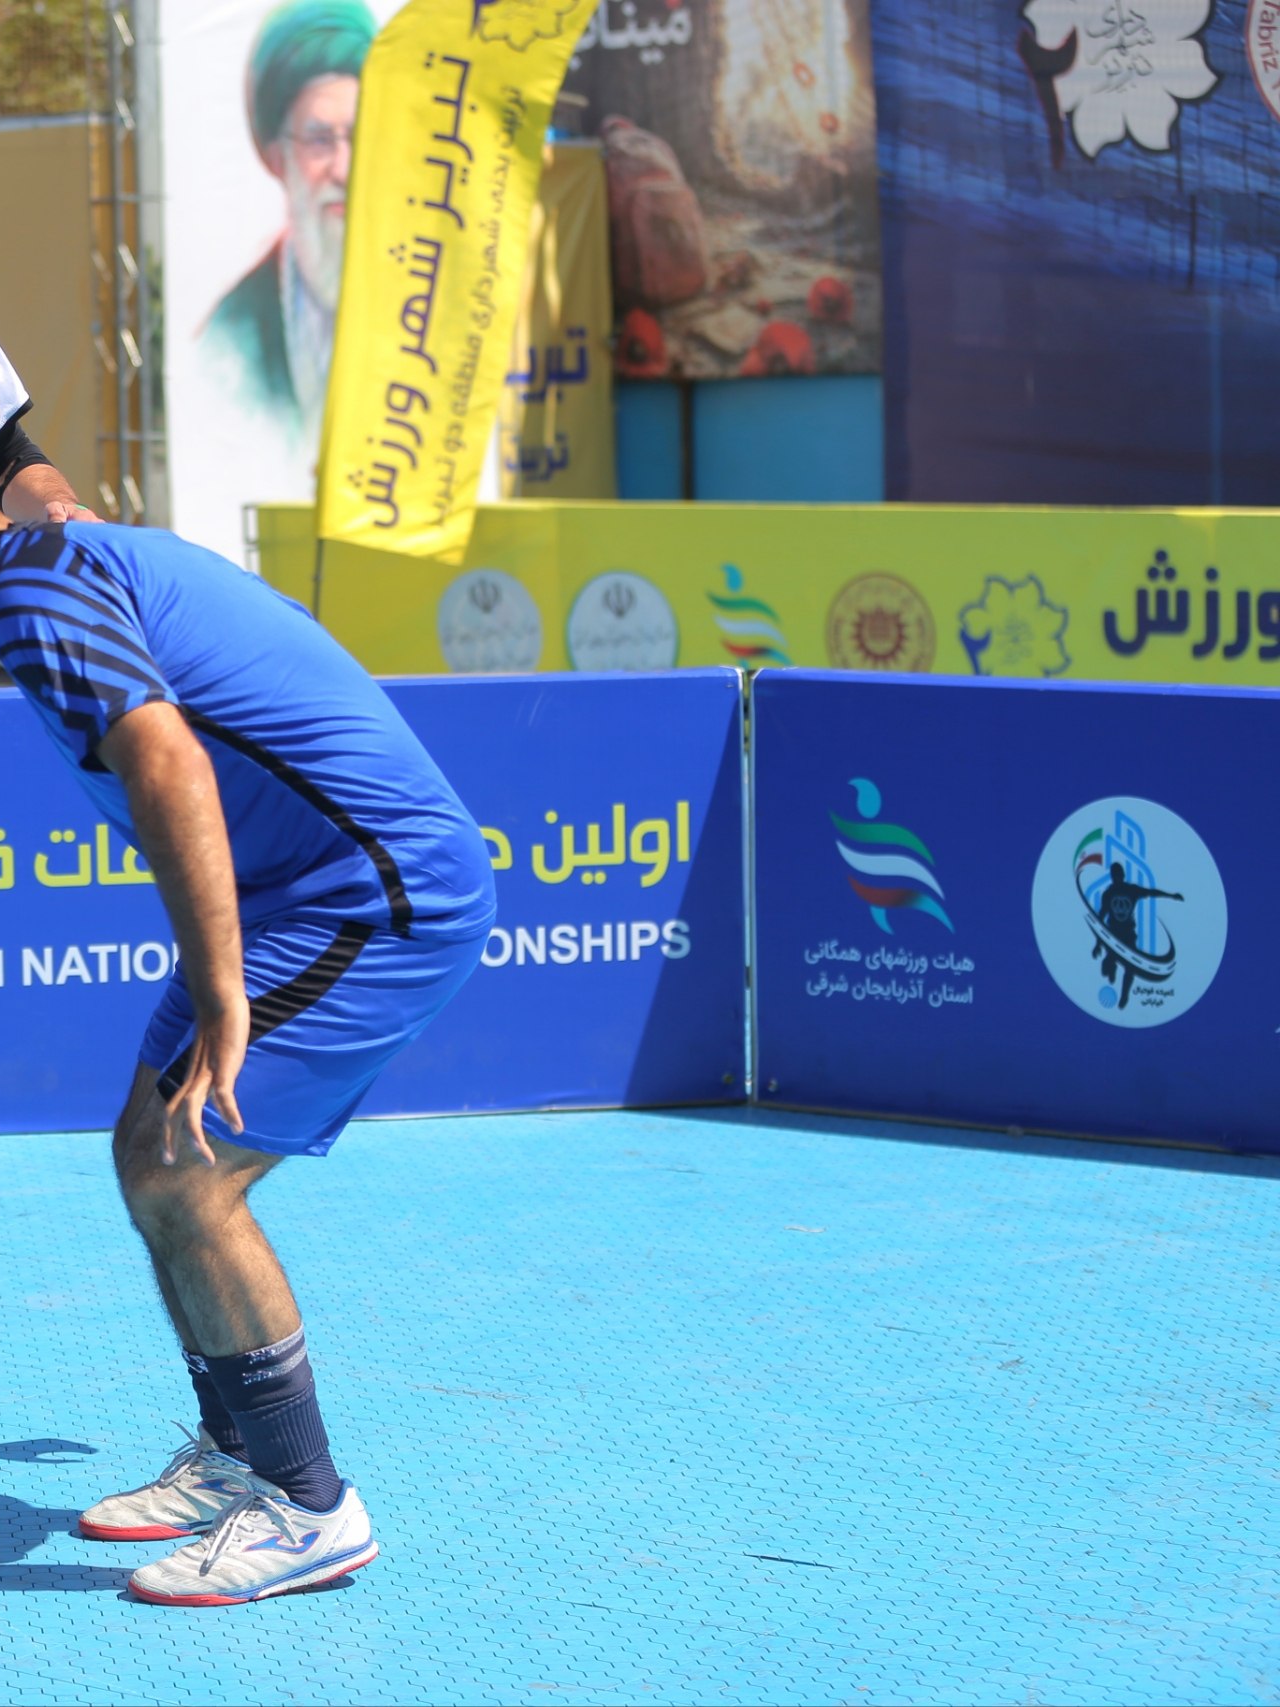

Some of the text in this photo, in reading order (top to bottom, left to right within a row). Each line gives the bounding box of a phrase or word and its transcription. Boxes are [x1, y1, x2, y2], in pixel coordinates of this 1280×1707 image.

[347, 52, 477, 528] تبریز شهر ورزش
[531, 800, 690, 889] اولین
[21, 941, 180, 987] NATIO
[480, 920, 691, 968] ONSHIPS
[804, 939, 862, 965] همگانی
[805, 971, 974, 1008] استان آذربایجان شرقی
